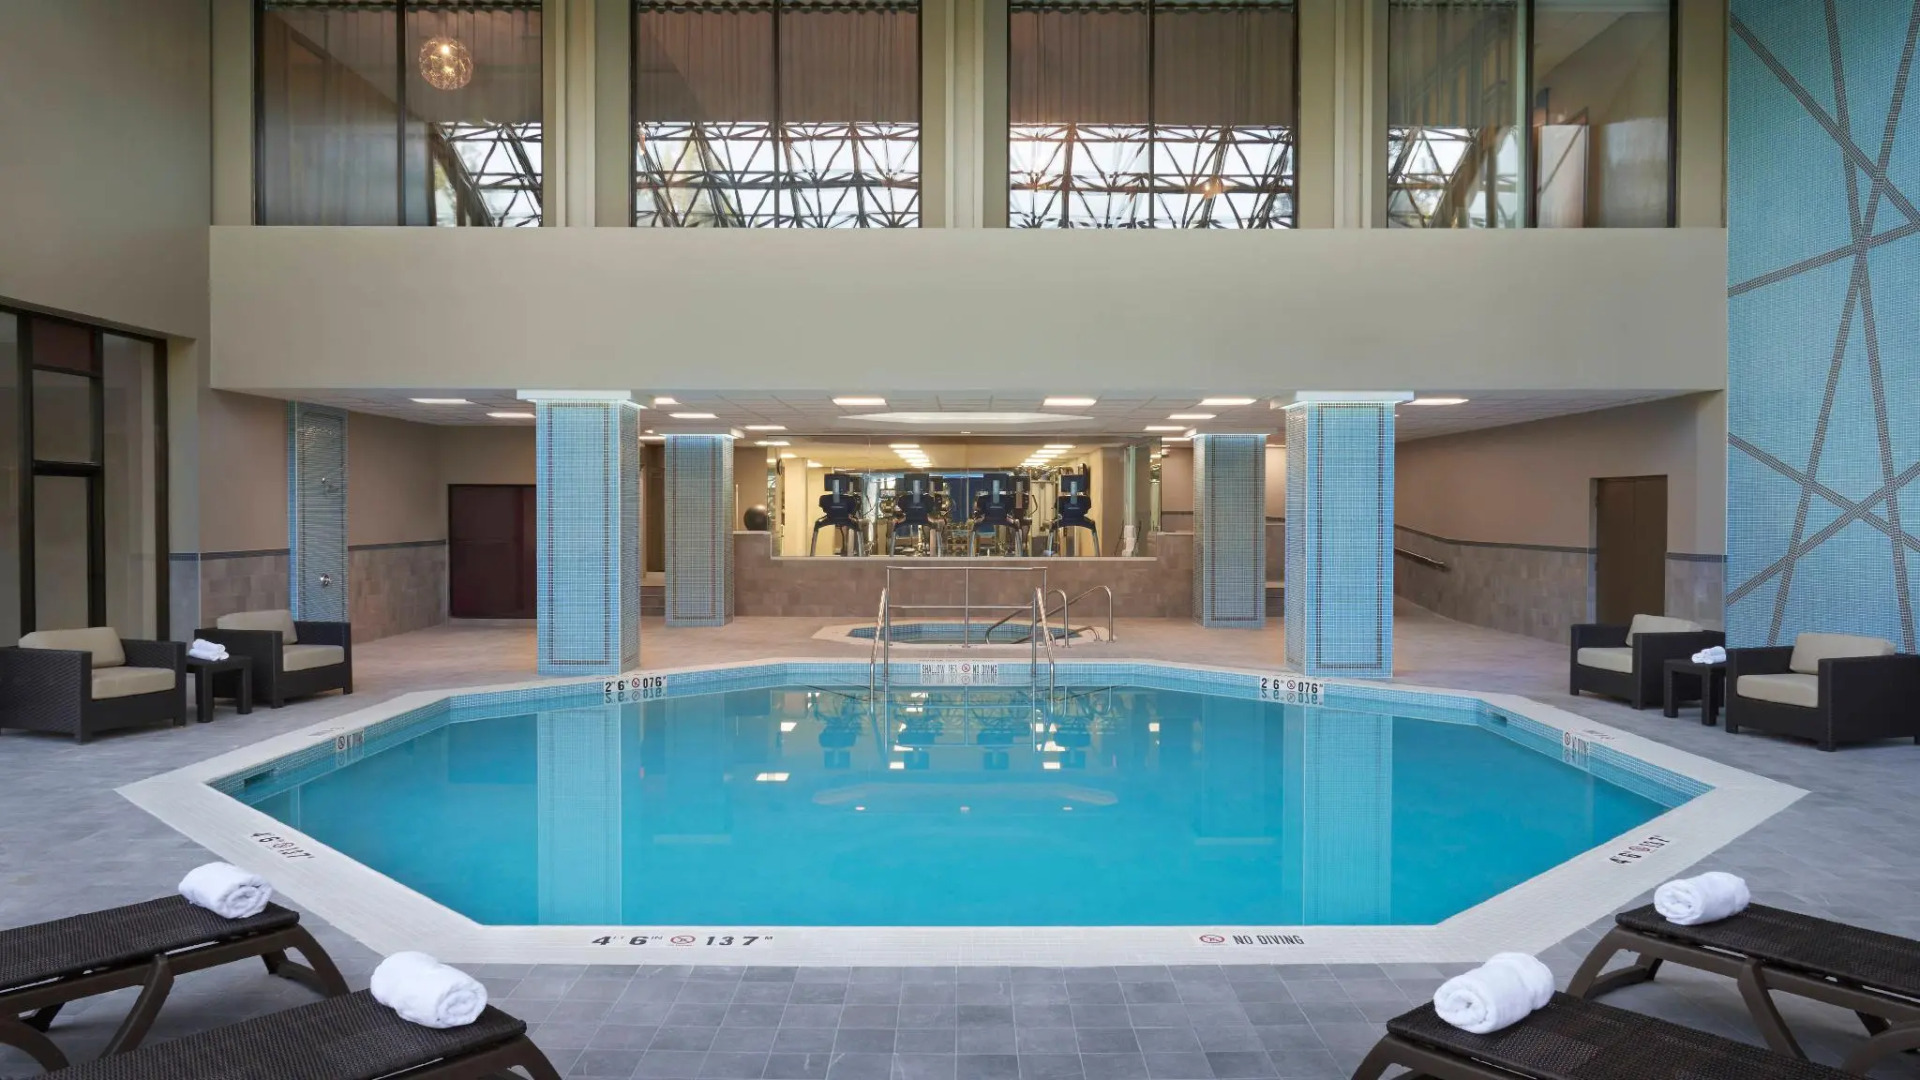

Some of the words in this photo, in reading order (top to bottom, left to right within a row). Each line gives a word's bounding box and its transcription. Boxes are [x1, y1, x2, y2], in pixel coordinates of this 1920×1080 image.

[605, 681, 612, 692] 2
[617, 680, 625, 690] 6
[1261, 677, 1267, 689] 2
[1273, 679, 1280, 690] 6
[592, 936, 611, 946] 4
[629, 936, 649, 946] 6
[1232, 935, 1254, 945] NO
[1256, 935, 1305, 945] DIVING
